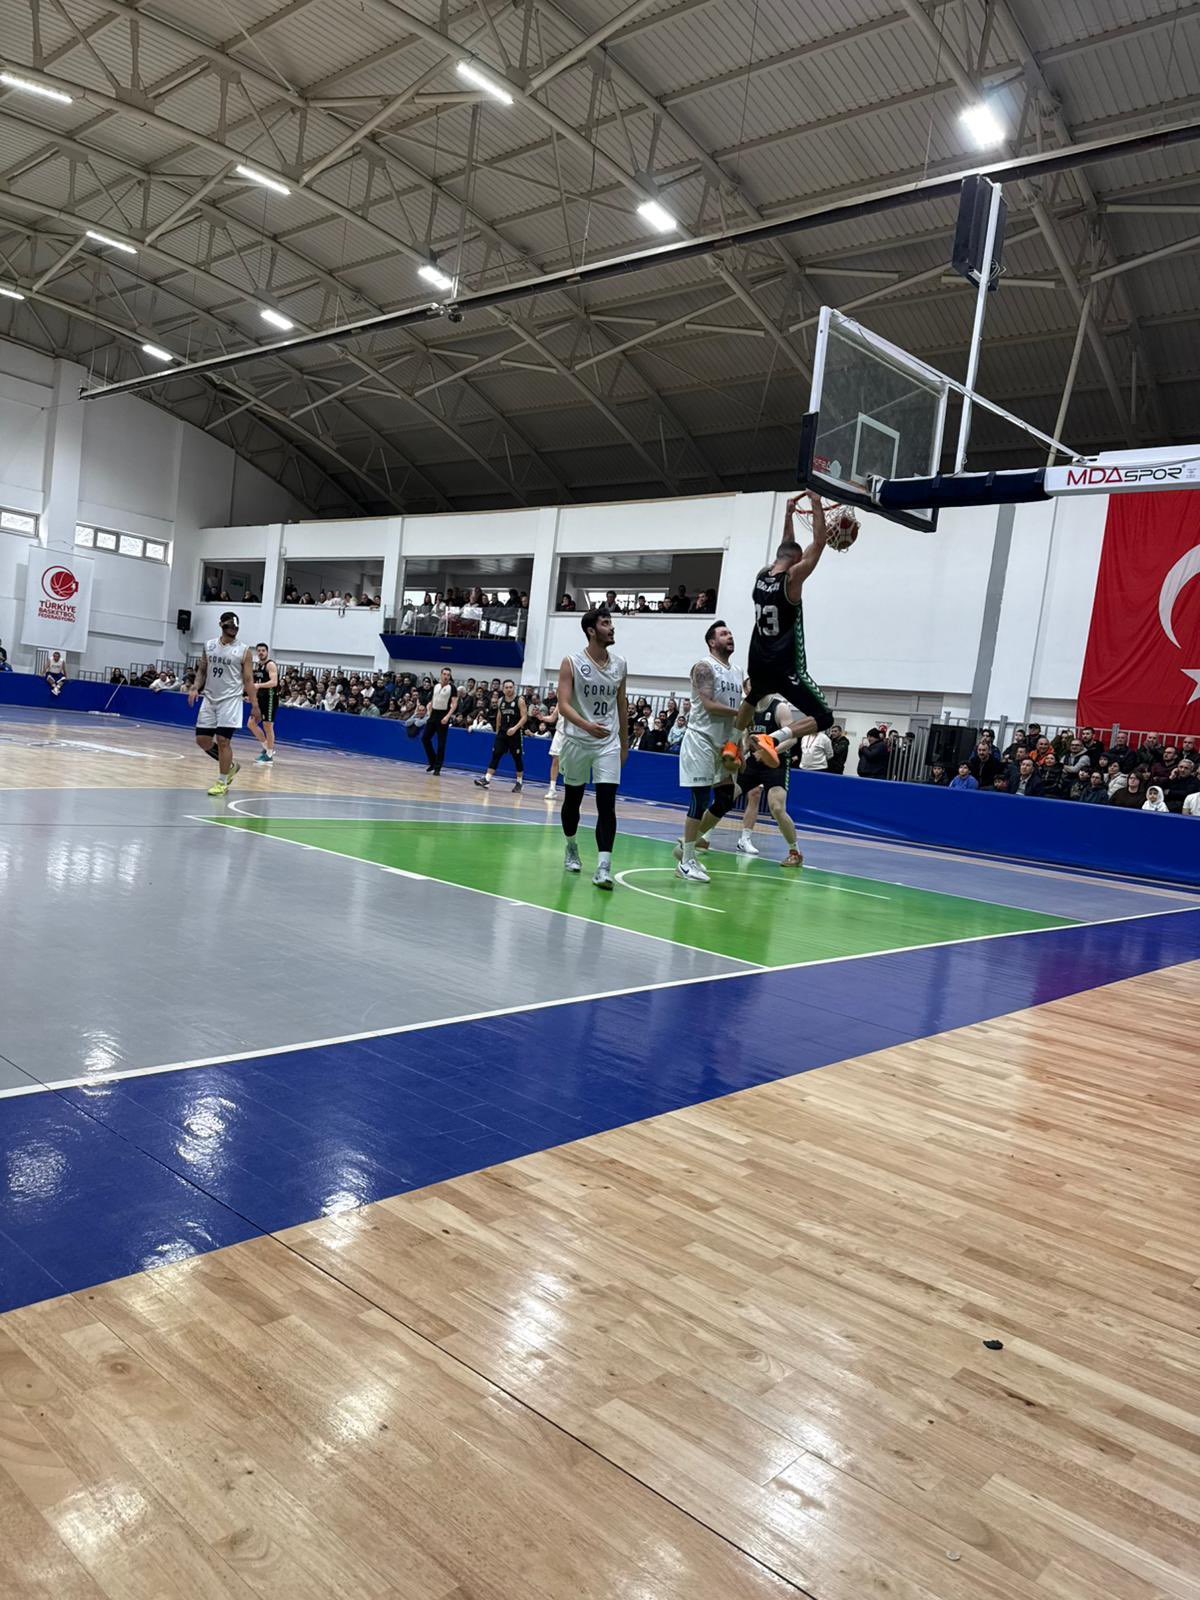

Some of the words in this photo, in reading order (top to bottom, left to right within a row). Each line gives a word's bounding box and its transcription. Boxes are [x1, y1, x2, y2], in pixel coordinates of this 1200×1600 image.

[39, 599, 77, 614] TÜRKİYE
[39, 607, 76, 619] BASKETBOL
[212, 666, 224, 678] 99
[593, 701, 608, 716] 20
[728, 697, 736, 708] 11
